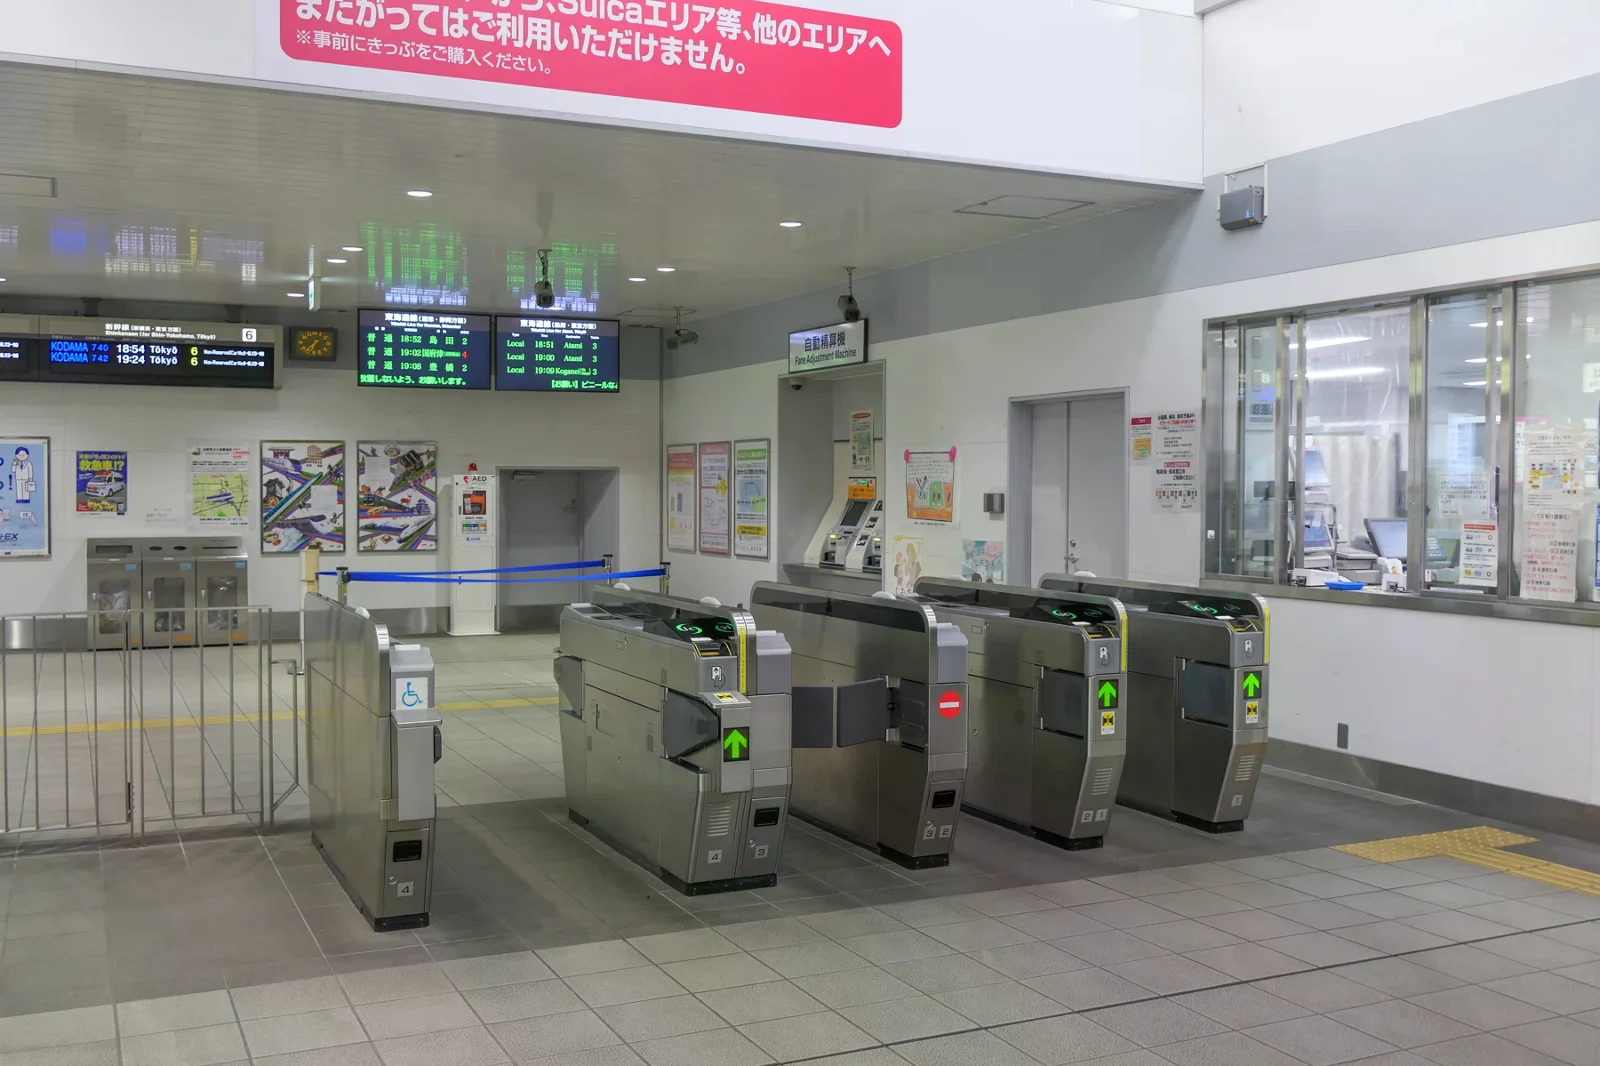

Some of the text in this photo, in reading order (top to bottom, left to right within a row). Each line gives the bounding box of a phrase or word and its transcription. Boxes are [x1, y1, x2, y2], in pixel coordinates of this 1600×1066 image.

[297, 0, 745, 75] またがってはご利用いただけません。
[245, 330, 253, 340] 6
[401, 335, 422, 343] 18:52
[804, 332, 846, 352] 自動精算機
[51, 342, 88, 352] KODAMA
[116, 344, 145, 354] 18:54
[190, 347, 198, 356] 6
[401, 348, 422, 356] 19:02
[51, 352, 88, 362] KODAMA
[116, 355, 145, 364] 19:24
[190, 357, 198, 366] 6
[795, 348, 856, 366] Fare Adjustment Machine
